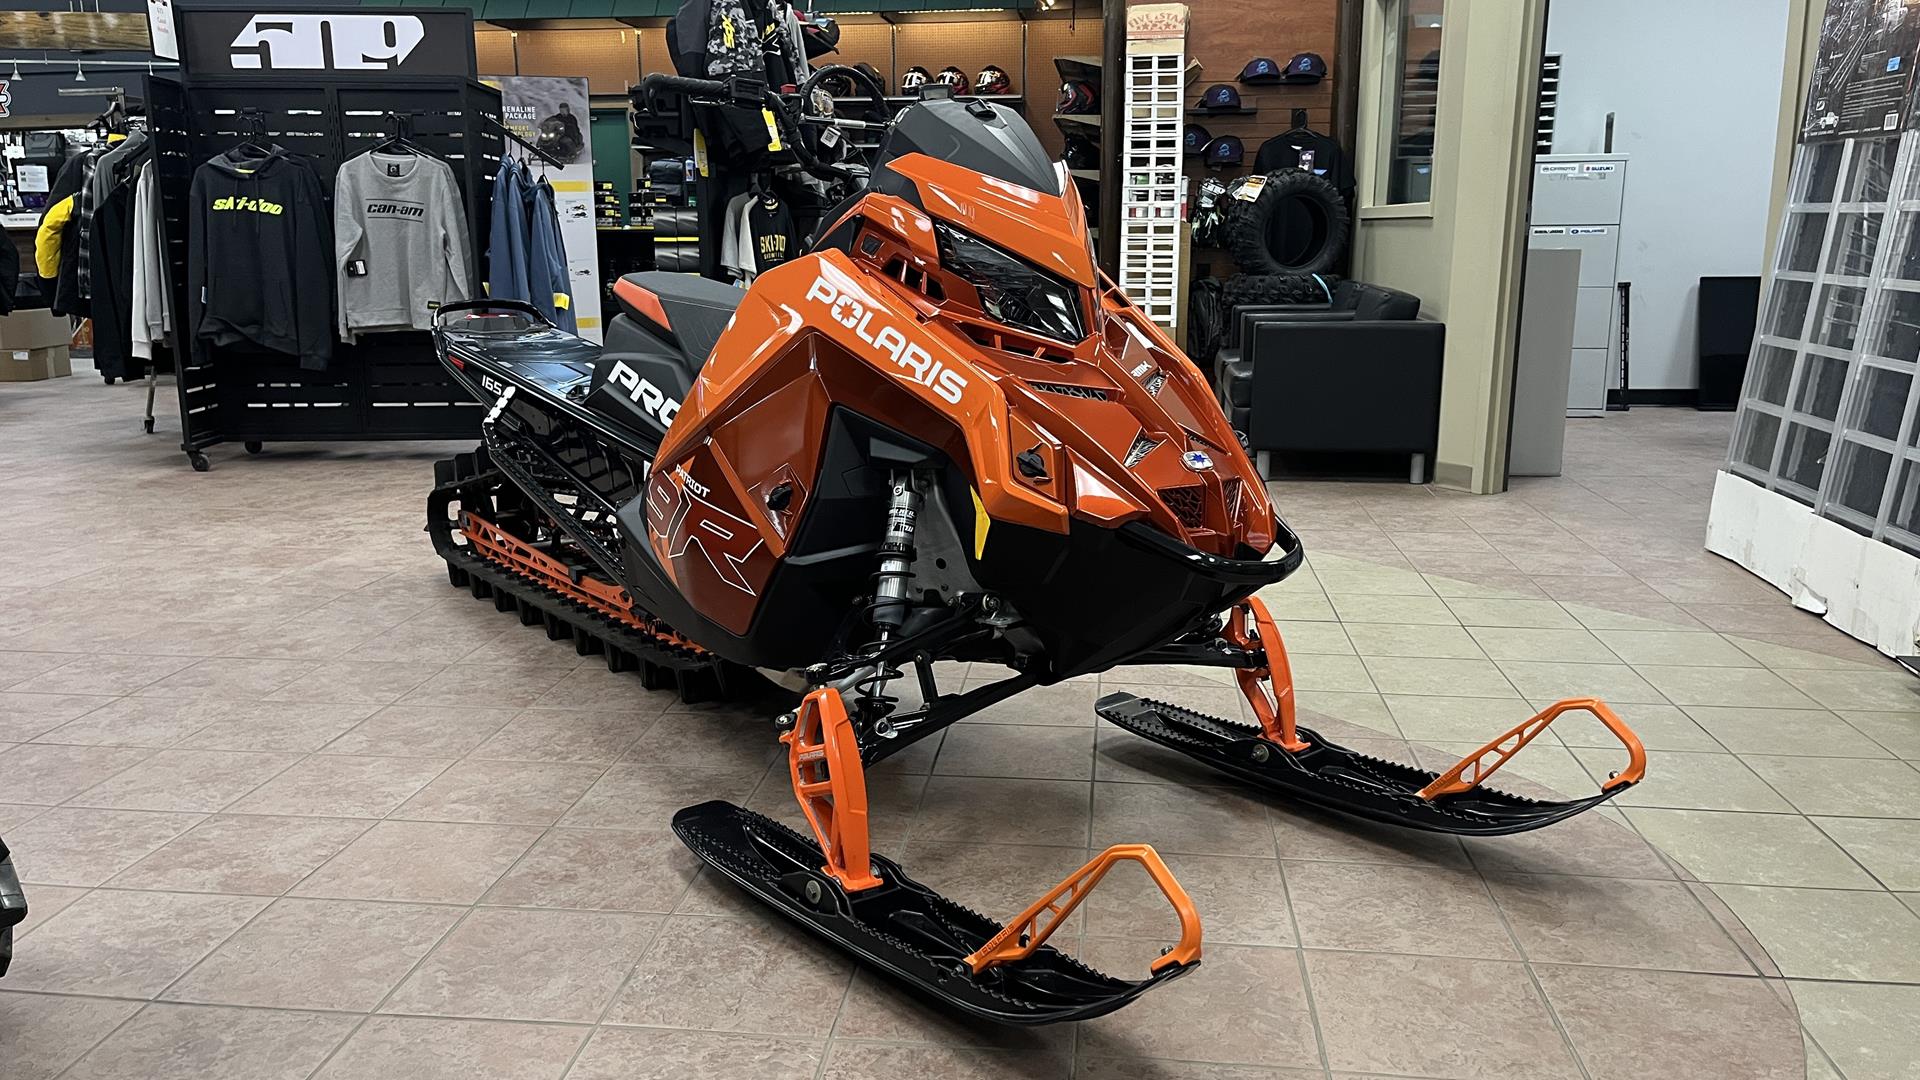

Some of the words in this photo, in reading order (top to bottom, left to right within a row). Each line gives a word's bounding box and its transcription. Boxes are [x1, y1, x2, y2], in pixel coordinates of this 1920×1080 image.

[367, 203, 424, 217] can-am
[805, 275, 968, 405] POLARIS
[481, 374, 503, 396] 165
[675, 463, 711, 498] PATRIOT
[980, 923, 1015, 956] POLARIS
